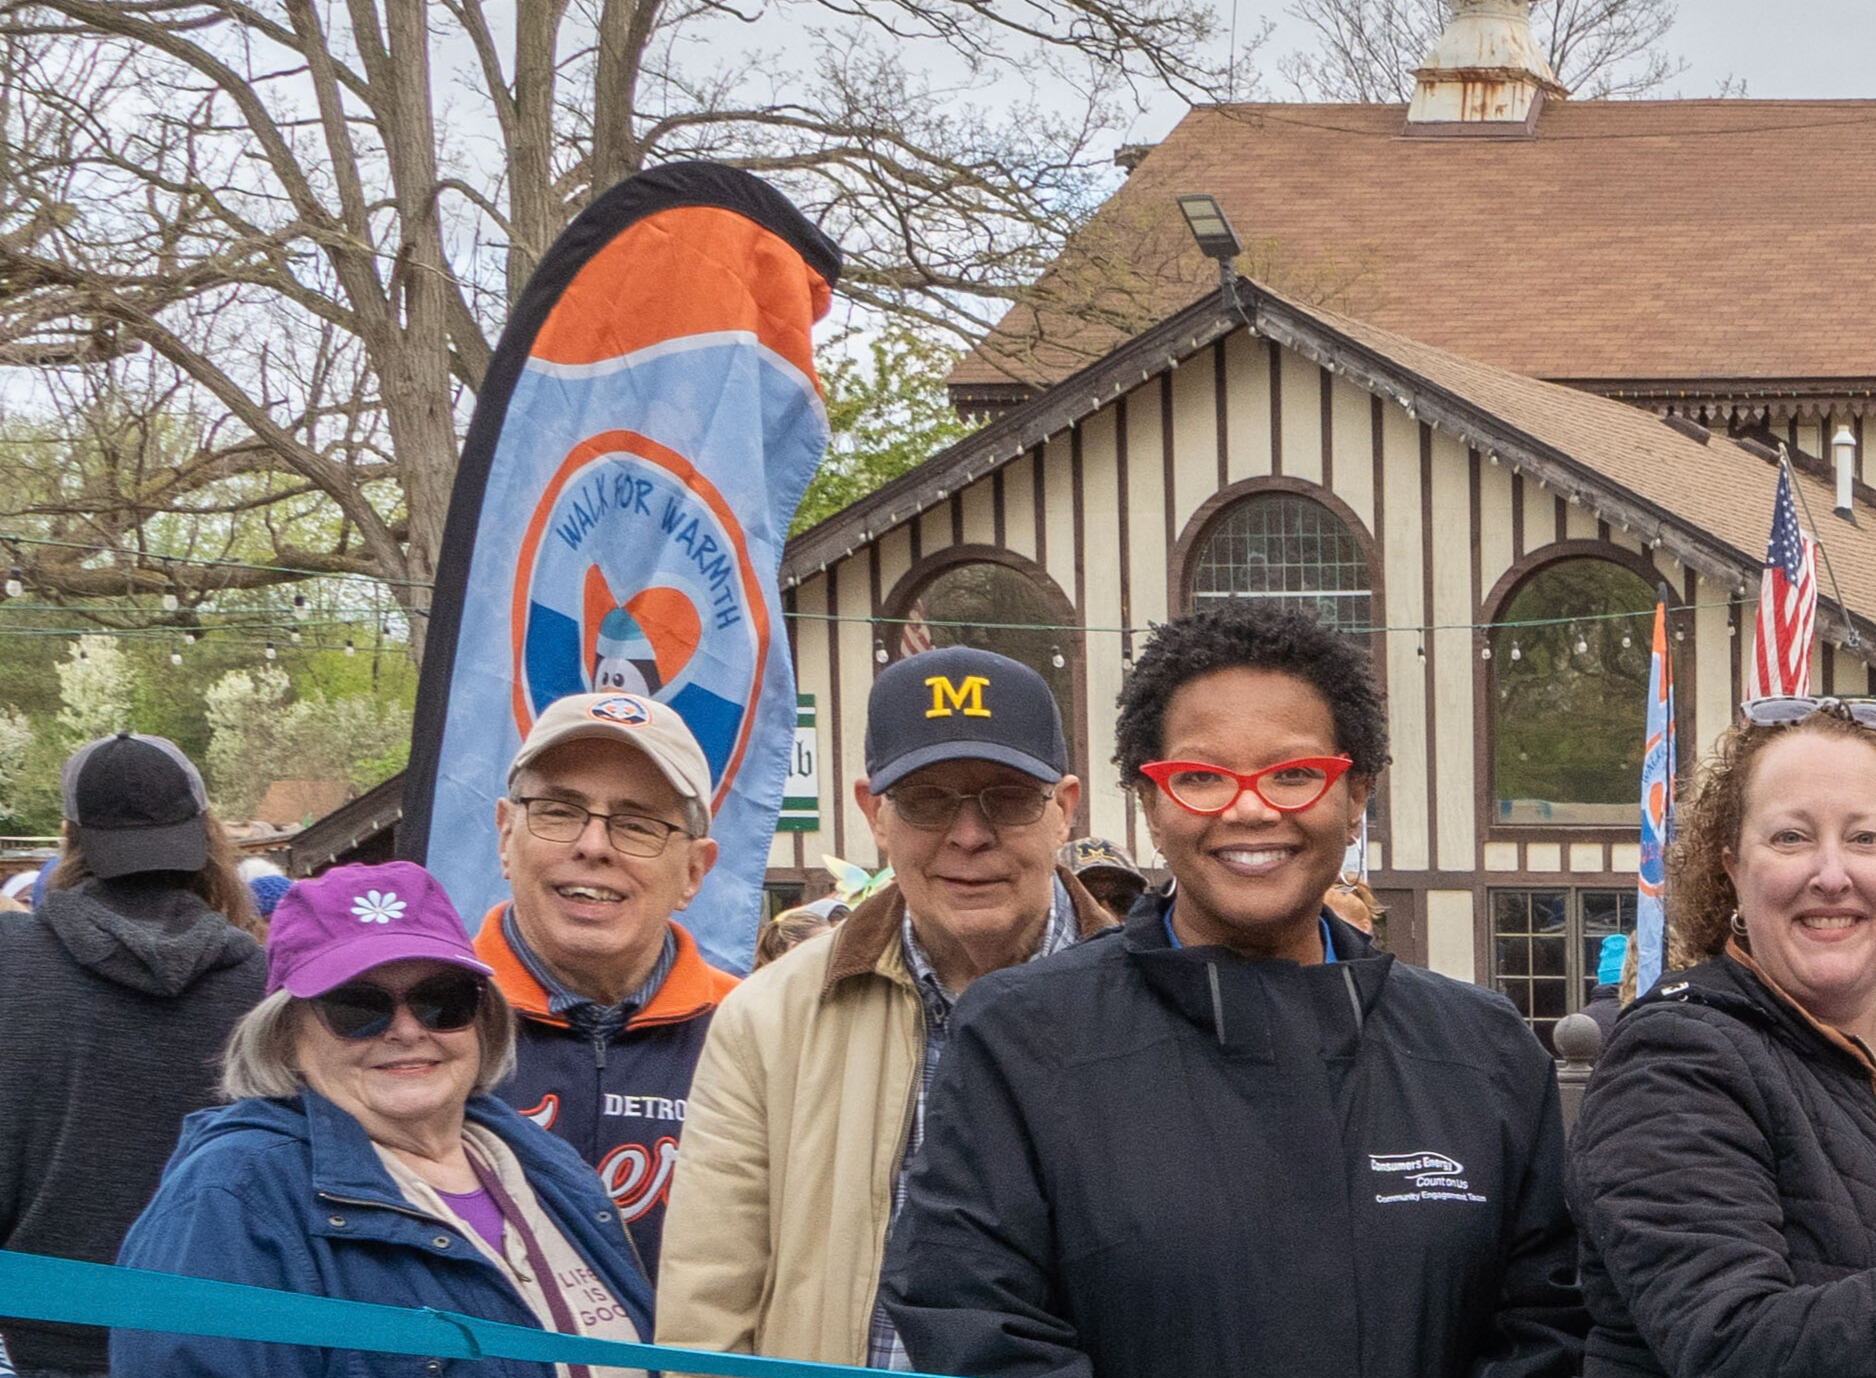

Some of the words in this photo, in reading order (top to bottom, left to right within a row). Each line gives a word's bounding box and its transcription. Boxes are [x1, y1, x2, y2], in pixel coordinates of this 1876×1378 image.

[556, 474, 609, 550] WALK
[614, 473, 654, 516] FOR
[661, 496, 741, 630] WARMTH
[924, 675, 992, 719] M
[1077, 843, 1116, 861] M
[1371, 1159, 1422, 1172] Consumers
[1422, 1156, 1452, 1171] Energy
[1416, 1177, 1446, 1188] Count
[1376, 1192, 1421, 1203] Community
[1421, 1191, 1468, 1201] Engagement
[582, 1287, 607, 1303] IS
